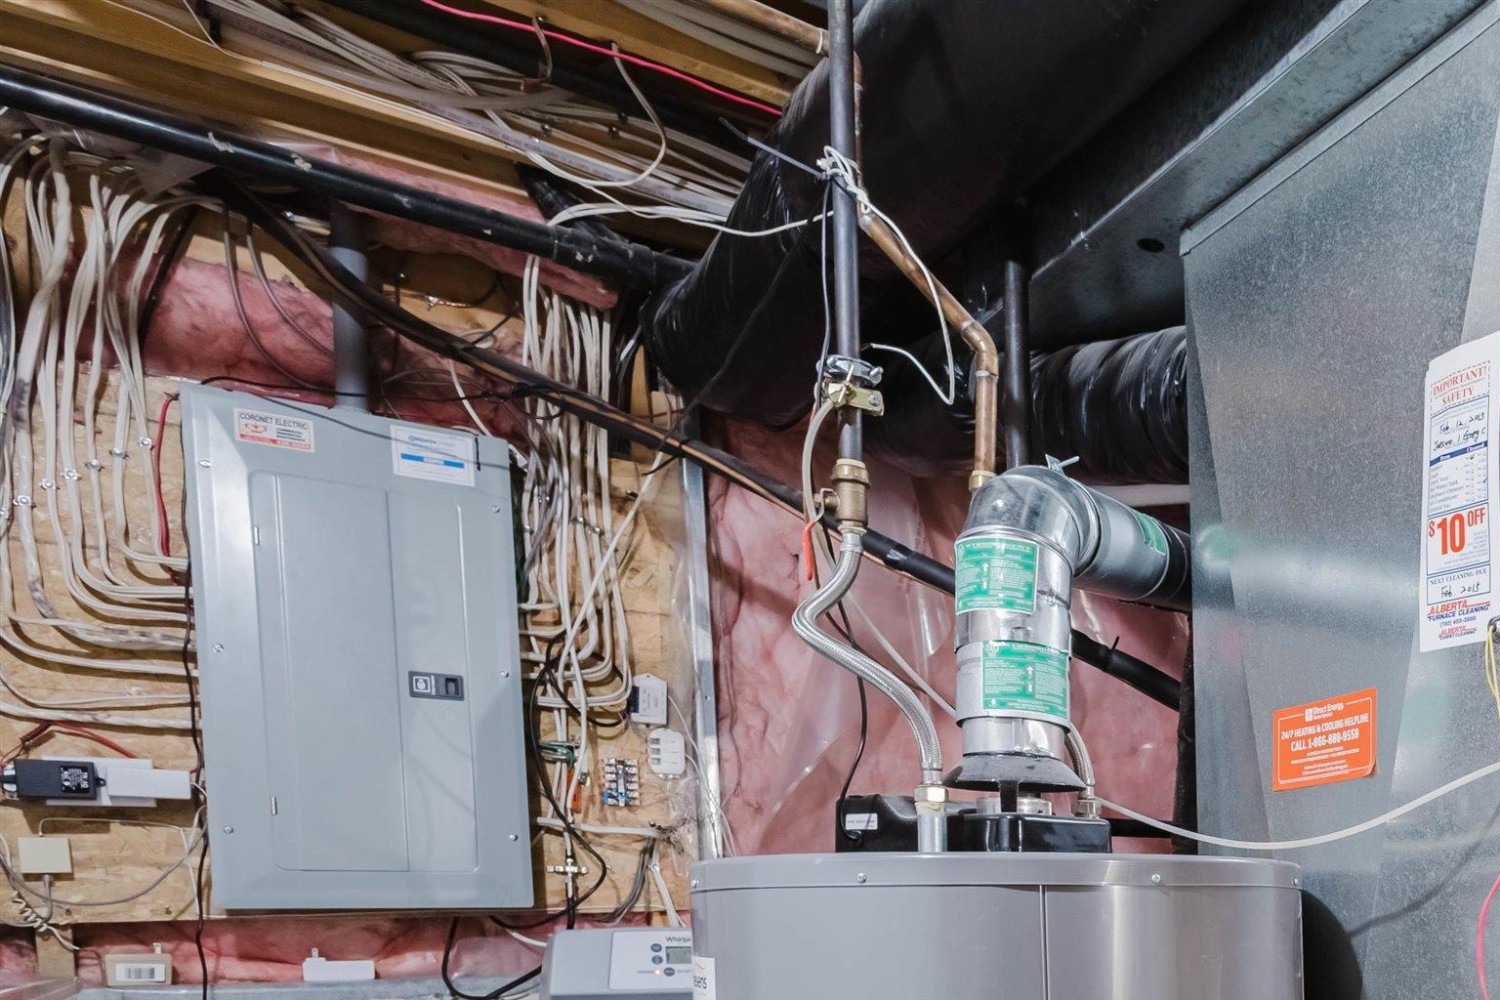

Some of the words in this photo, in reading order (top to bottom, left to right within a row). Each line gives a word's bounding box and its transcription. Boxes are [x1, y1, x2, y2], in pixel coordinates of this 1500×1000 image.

[1433, 366, 1487, 396] IMPORTANT!
[1442, 386, 1474, 405] SAFETY
[240, 412, 273, 424] CORONET
[275, 418, 308, 430] ELECTRIC
[1468, 507, 1486, 527] OFF
[1430, 577, 1445, 586] NEXT
[1445, 571, 1474, 583] CLEANING
[1475, 568, 1487, 576] DUE
[1427, 600, 1469, 616] ALBERTA
[1427, 611, 1457, 623] FURNACE
[1458, 603, 1490, 616] CLEANING
[1281, 730, 1294, 740] 24/7
[1294, 725, 1317, 737] HEATING
[1321, 719, 1344, 732] COOLING
[1344, 713, 1369, 727] HELPLINE
[1291, 740, 1307, 752] CALL
